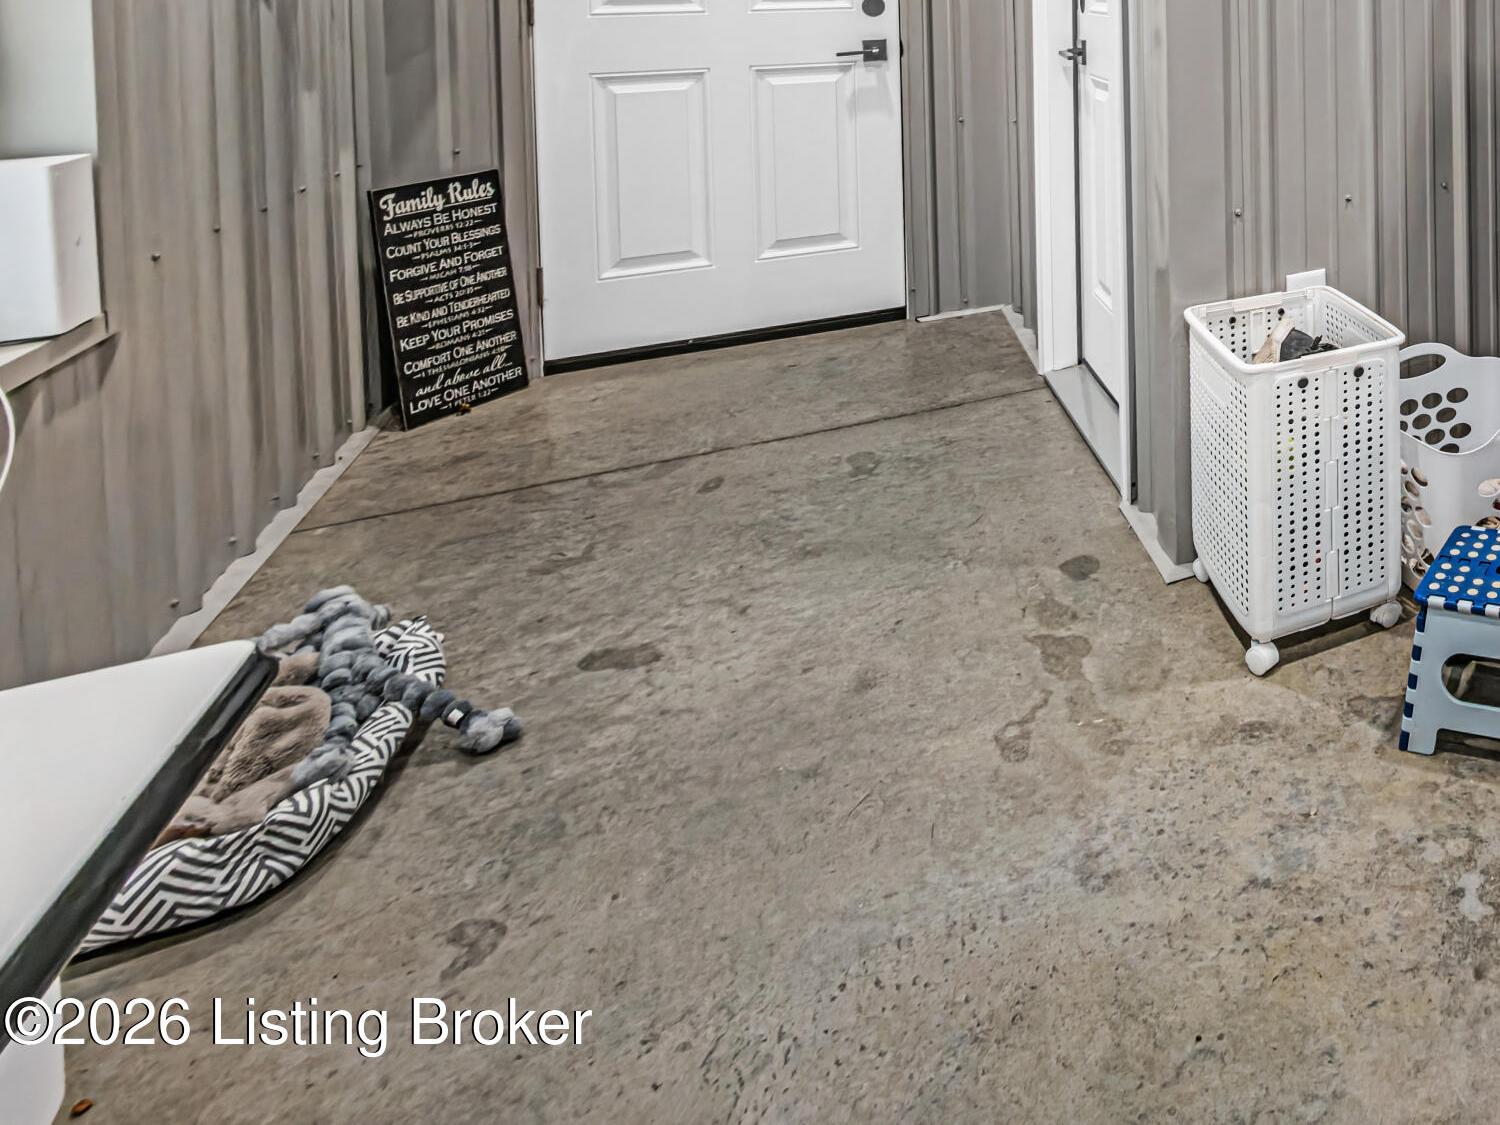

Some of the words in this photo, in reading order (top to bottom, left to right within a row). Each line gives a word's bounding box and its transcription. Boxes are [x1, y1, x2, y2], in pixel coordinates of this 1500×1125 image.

[379, 186, 446, 221] Family
[447, 178, 495, 204] Rules
[384, 216, 432, 236] ALWAYS
[433, 212, 450, 225] BE
[452, 203, 498, 221] HONEST
[386, 241, 422, 259] COUNT
[422, 236, 450, 250] YOUR
[451, 224, 501, 244] BLESSINGS
[389, 261, 438, 282] FORGIVE
[439, 256, 462, 270] AND
[463, 245, 504, 264] FORGET
[392, 293, 405, 305] BE
[404, 283, 448, 303] SUPPORTIVE
[449, 279, 460, 290] OF
[460, 274, 477, 287] ONE
[476, 266, 508, 283] ANOTHER
[396, 315, 410, 328] BE
[410, 310, 430, 325] KIND
[431, 306, 448, 320] AND
[448, 288, 511, 313] TENDERHEARTED
[399, 334, 430, 352] KEEP
[431, 325, 461, 342] YOUR
[462, 309, 514, 333] PROMISES
[403, 351, 452, 375] COMFORT
[453, 344, 475, 358] ONE
[475, 331, 518, 352] ANOTHER
[410, 398, 443, 415] LOVE
[443, 384, 471, 402] ONE
[471, 367, 522, 393] ANOTHER
[415, 373, 445, 397] and
[444, 367, 481, 387] above
